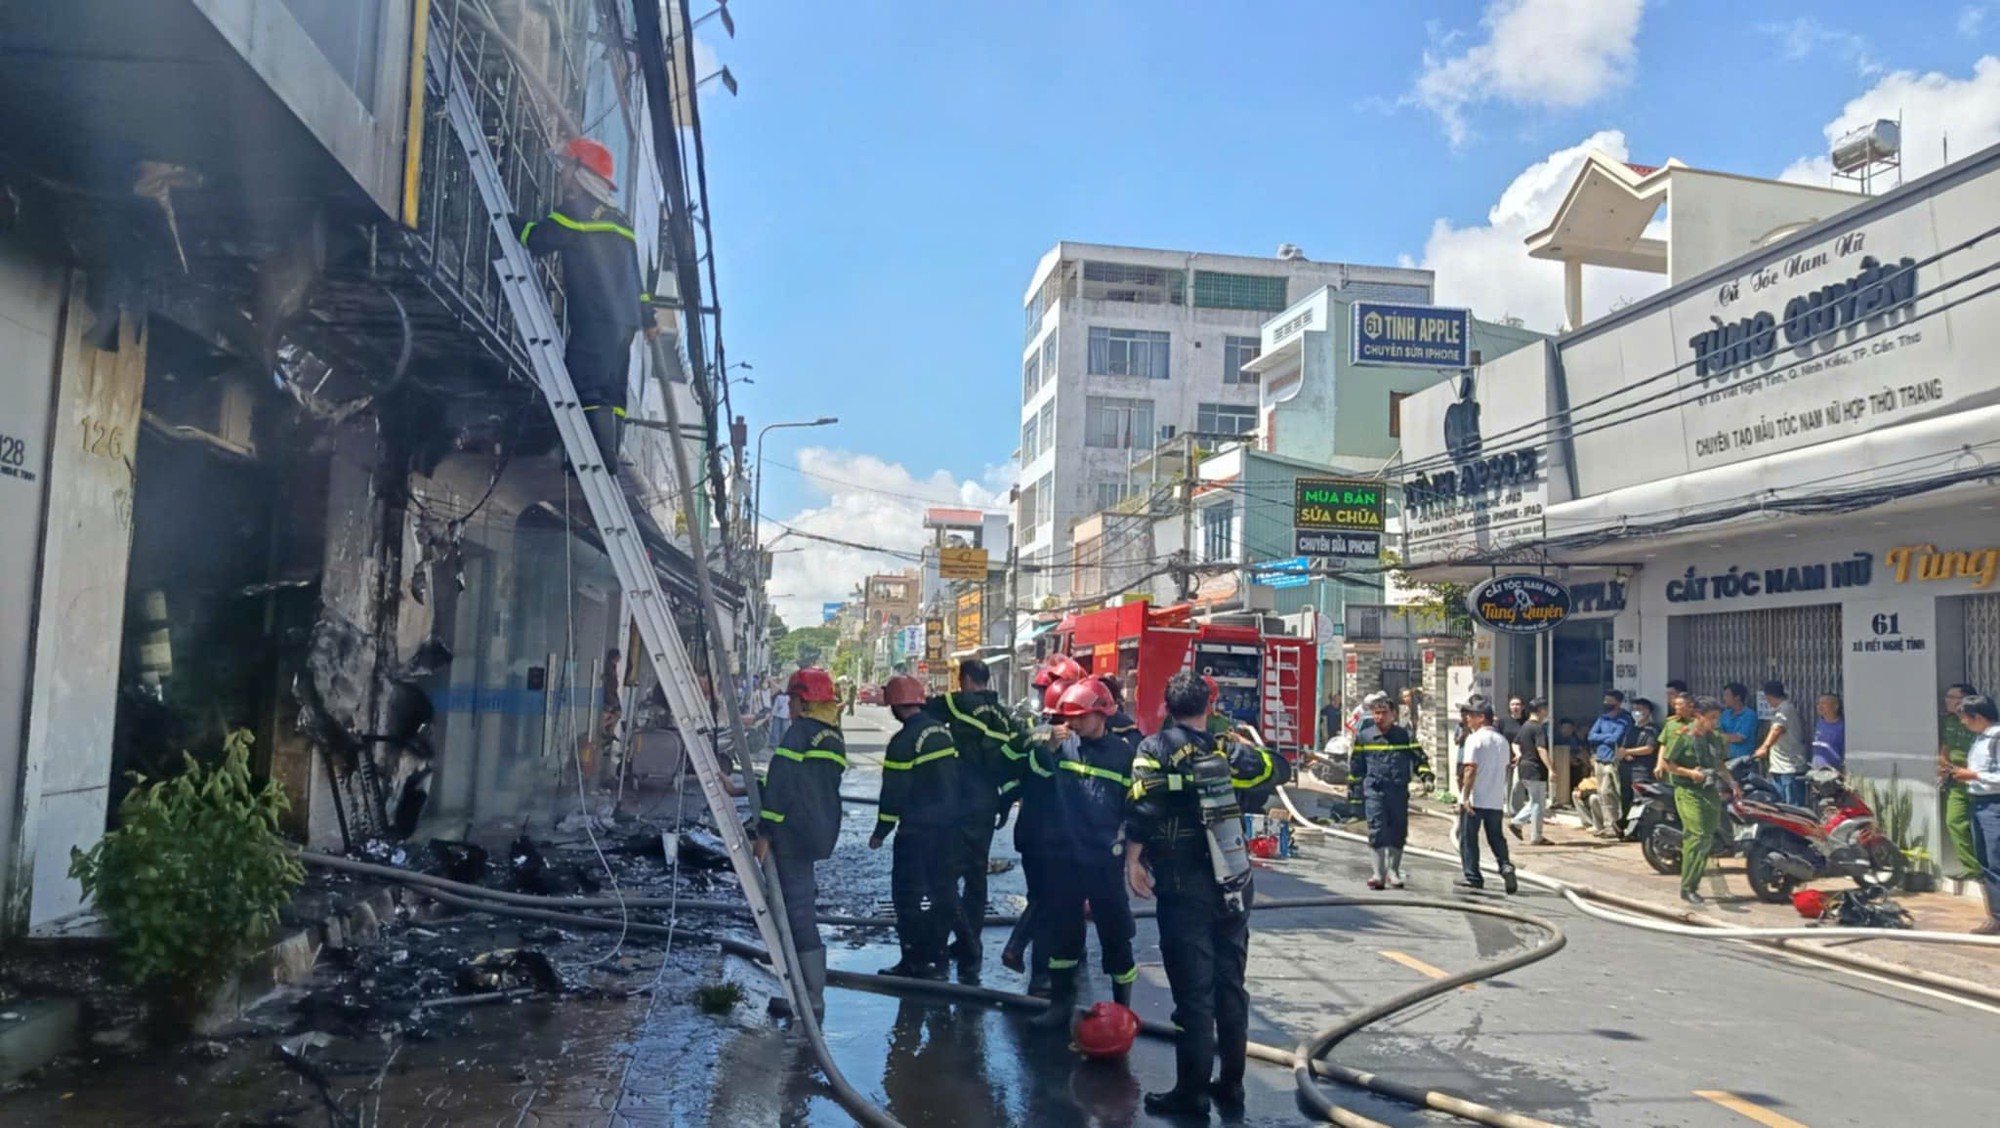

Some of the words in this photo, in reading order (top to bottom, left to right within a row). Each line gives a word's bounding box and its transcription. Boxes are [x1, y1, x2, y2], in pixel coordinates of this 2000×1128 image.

[1784, 252, 1828, 278] Nam
[1366, 318, 1379, 334] 61
[1419, 318, 1460, 344] APPLE
[1689, 311, 1777, 378] TÙNG
[1696, 430, 1730, 457] CHUYÊN
[1732, 427, 1752, 450] TẠO
[1776, 412, 1799, 436] TÓC
[1800, 409, 1823, 432] NAM
[1826, 400, 1842, 425] NỮ
[1843, 396, 1866, 425] HỢP
[1869, 385, 1897, 415] THỜI
[1899, 378, 1943, 405] TRANG
[81, 415, 124, 461] 126
[1305, 490, 1339, 503] MUA
[1343, 489, 1376, 505] BÁN
[1301, 505, 1331, 521] SỬA
[1336, 508, 1379, 524] CHỮA
[1666, 565, 1709, 603] CẮT
[1710, 565, 1761, 599] TÓC
[1764, 564, 1826, 594] NAM
[1831, 551, 1874, 588] NỮ
[1884, 543, 2000, 588] Tùng
[1567, 581, 1626, 614] PPLE
[1871, 613, 1901, 635] 61
